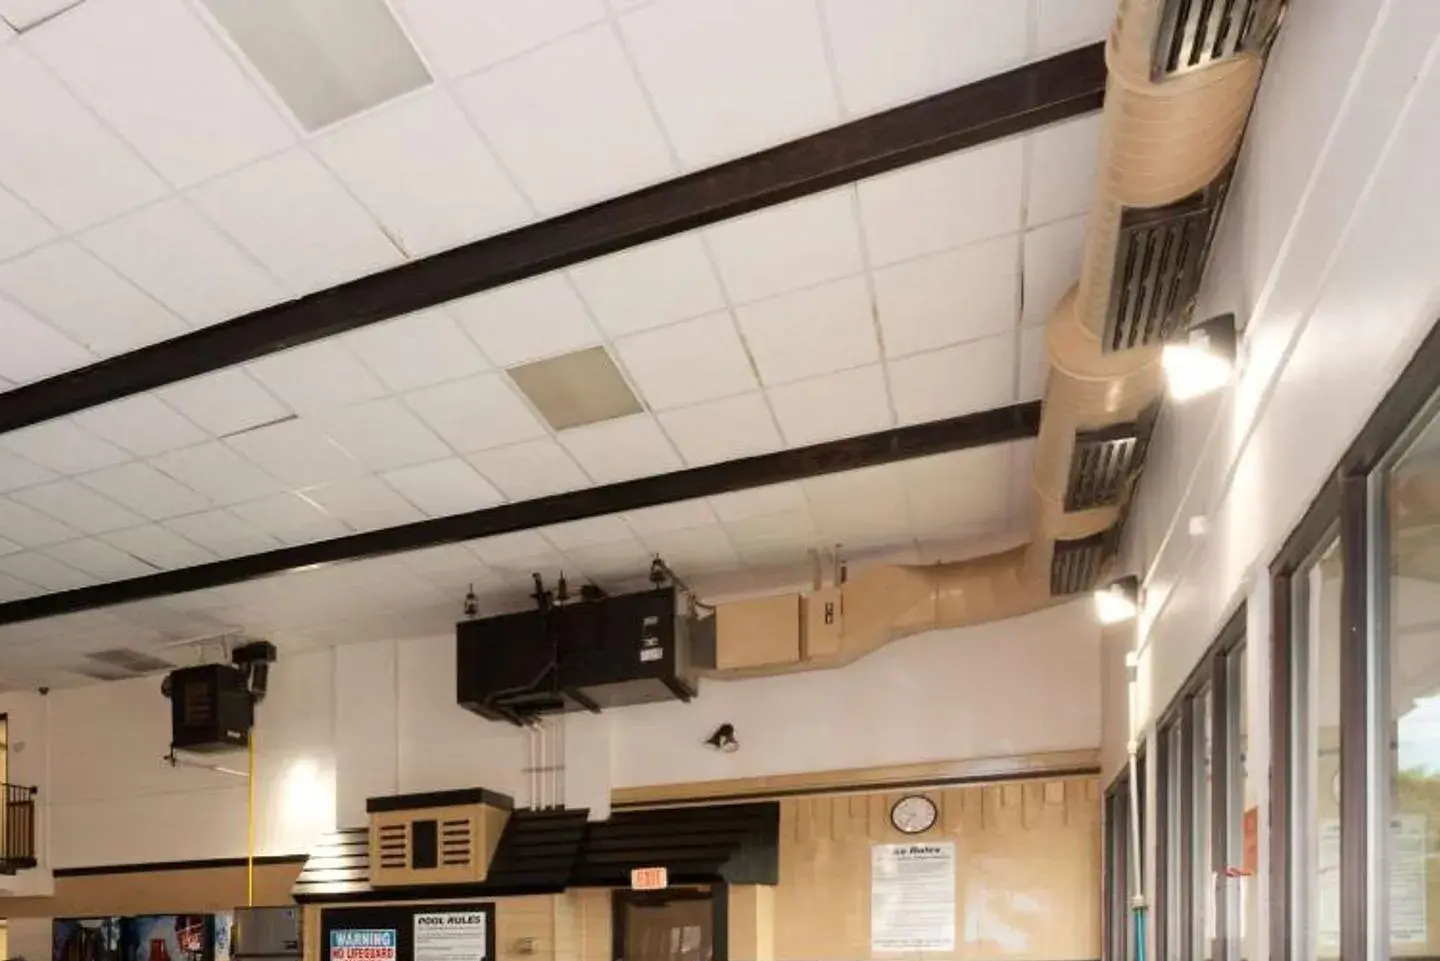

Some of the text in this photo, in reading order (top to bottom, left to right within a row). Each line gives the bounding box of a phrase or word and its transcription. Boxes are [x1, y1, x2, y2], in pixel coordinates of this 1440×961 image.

[418, 915, 481, 925] POOL RULES
[335, 932, 391, 946] WARNING
[333, 948, 393, 959] NO LIFEGUARD
